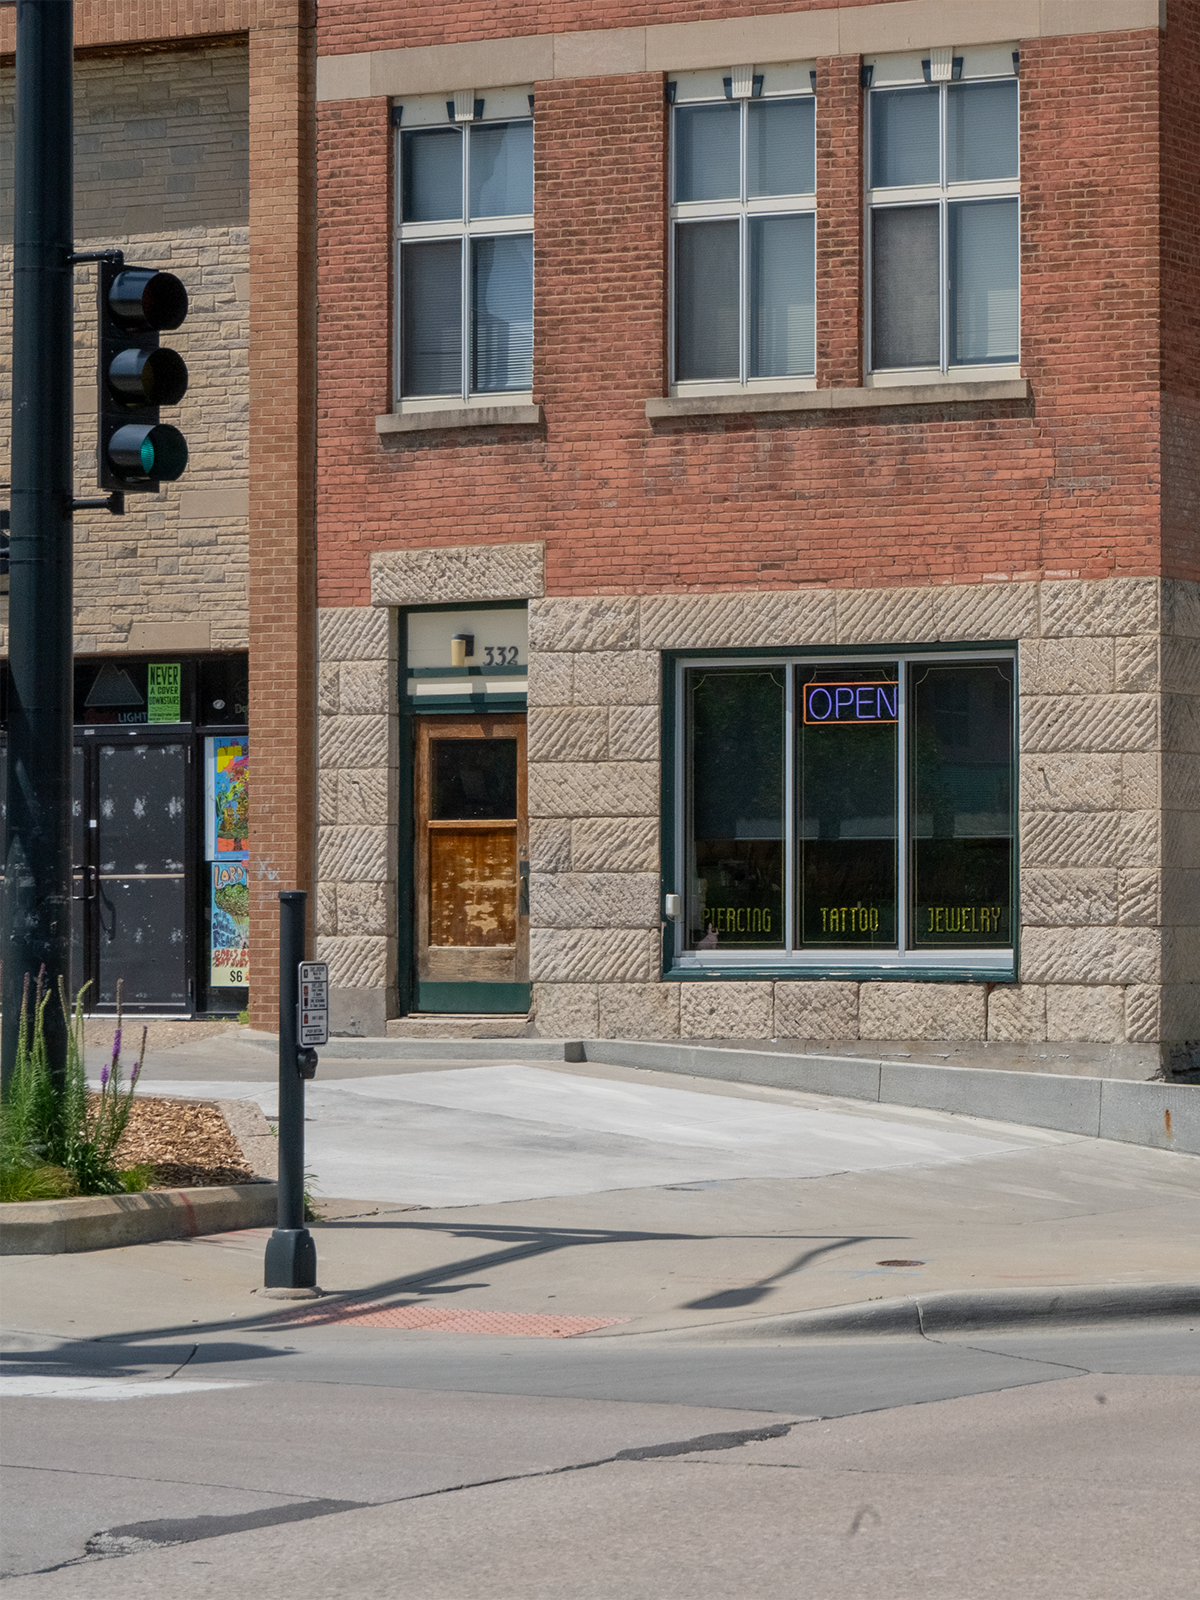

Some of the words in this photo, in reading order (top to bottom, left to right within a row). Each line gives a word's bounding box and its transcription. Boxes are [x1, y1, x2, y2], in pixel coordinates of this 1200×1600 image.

[483, 646, 519, 667] 332
[150, 666, 178, 686] NEVER
[149, 696, 180, 706] DOWNSTAIRS
[150, 686, 155, 695] A
[157, 686, 179, 695] COVER
[809, 687, 897, 720] OPEN
[118, 712, 148, 723] LIGHT
[214, 865, 243, 889] LORD
[702, 907, 771, 933] PIERCING
[820, 907, 879, 932] TATTOO
[927, 907, 1001, 933] JEWELRY
[229, 970, 243, 983] $6
